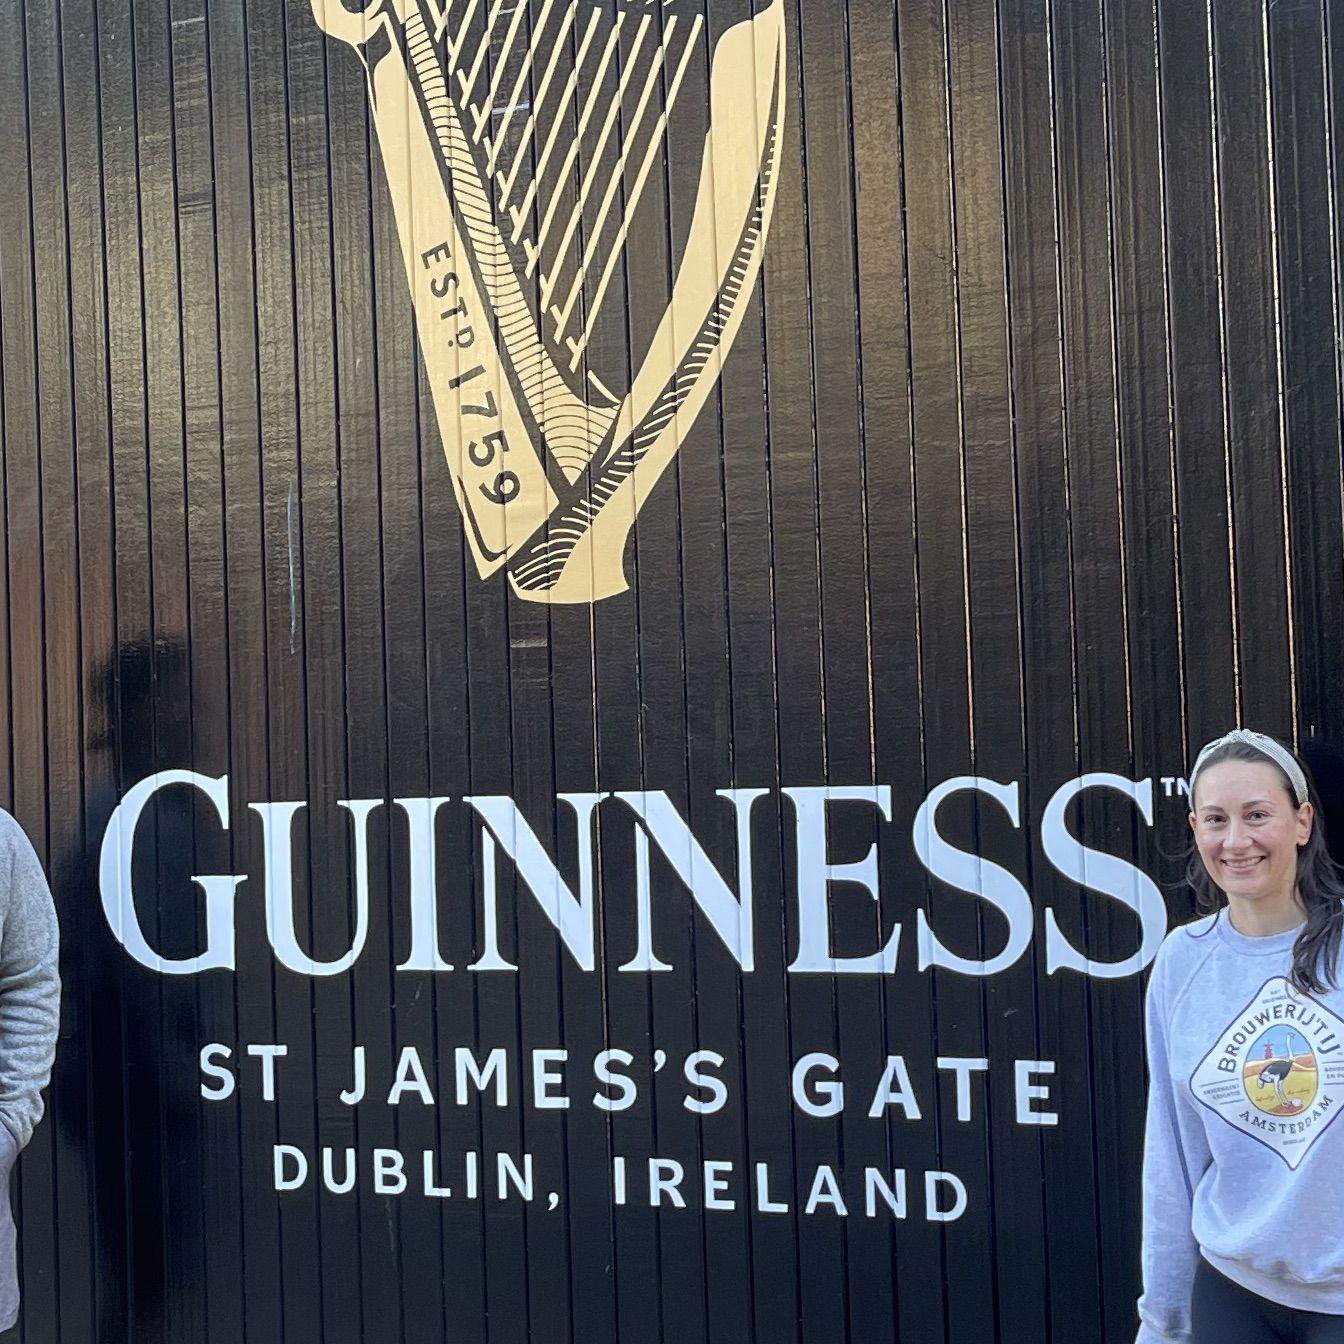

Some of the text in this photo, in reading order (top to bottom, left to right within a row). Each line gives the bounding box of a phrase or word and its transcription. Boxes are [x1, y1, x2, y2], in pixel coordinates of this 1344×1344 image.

[448, 364, 521, 505] 1759
[98, 769, 1168, 978] GUINNESS
[200, 1043, 1059, 1125] ST JAMES'S GATE
[1239, 1094, 1333, 1134] AMSTERDAM
[273, 1144, 968, 1222] DUBLIN, IRELAND
